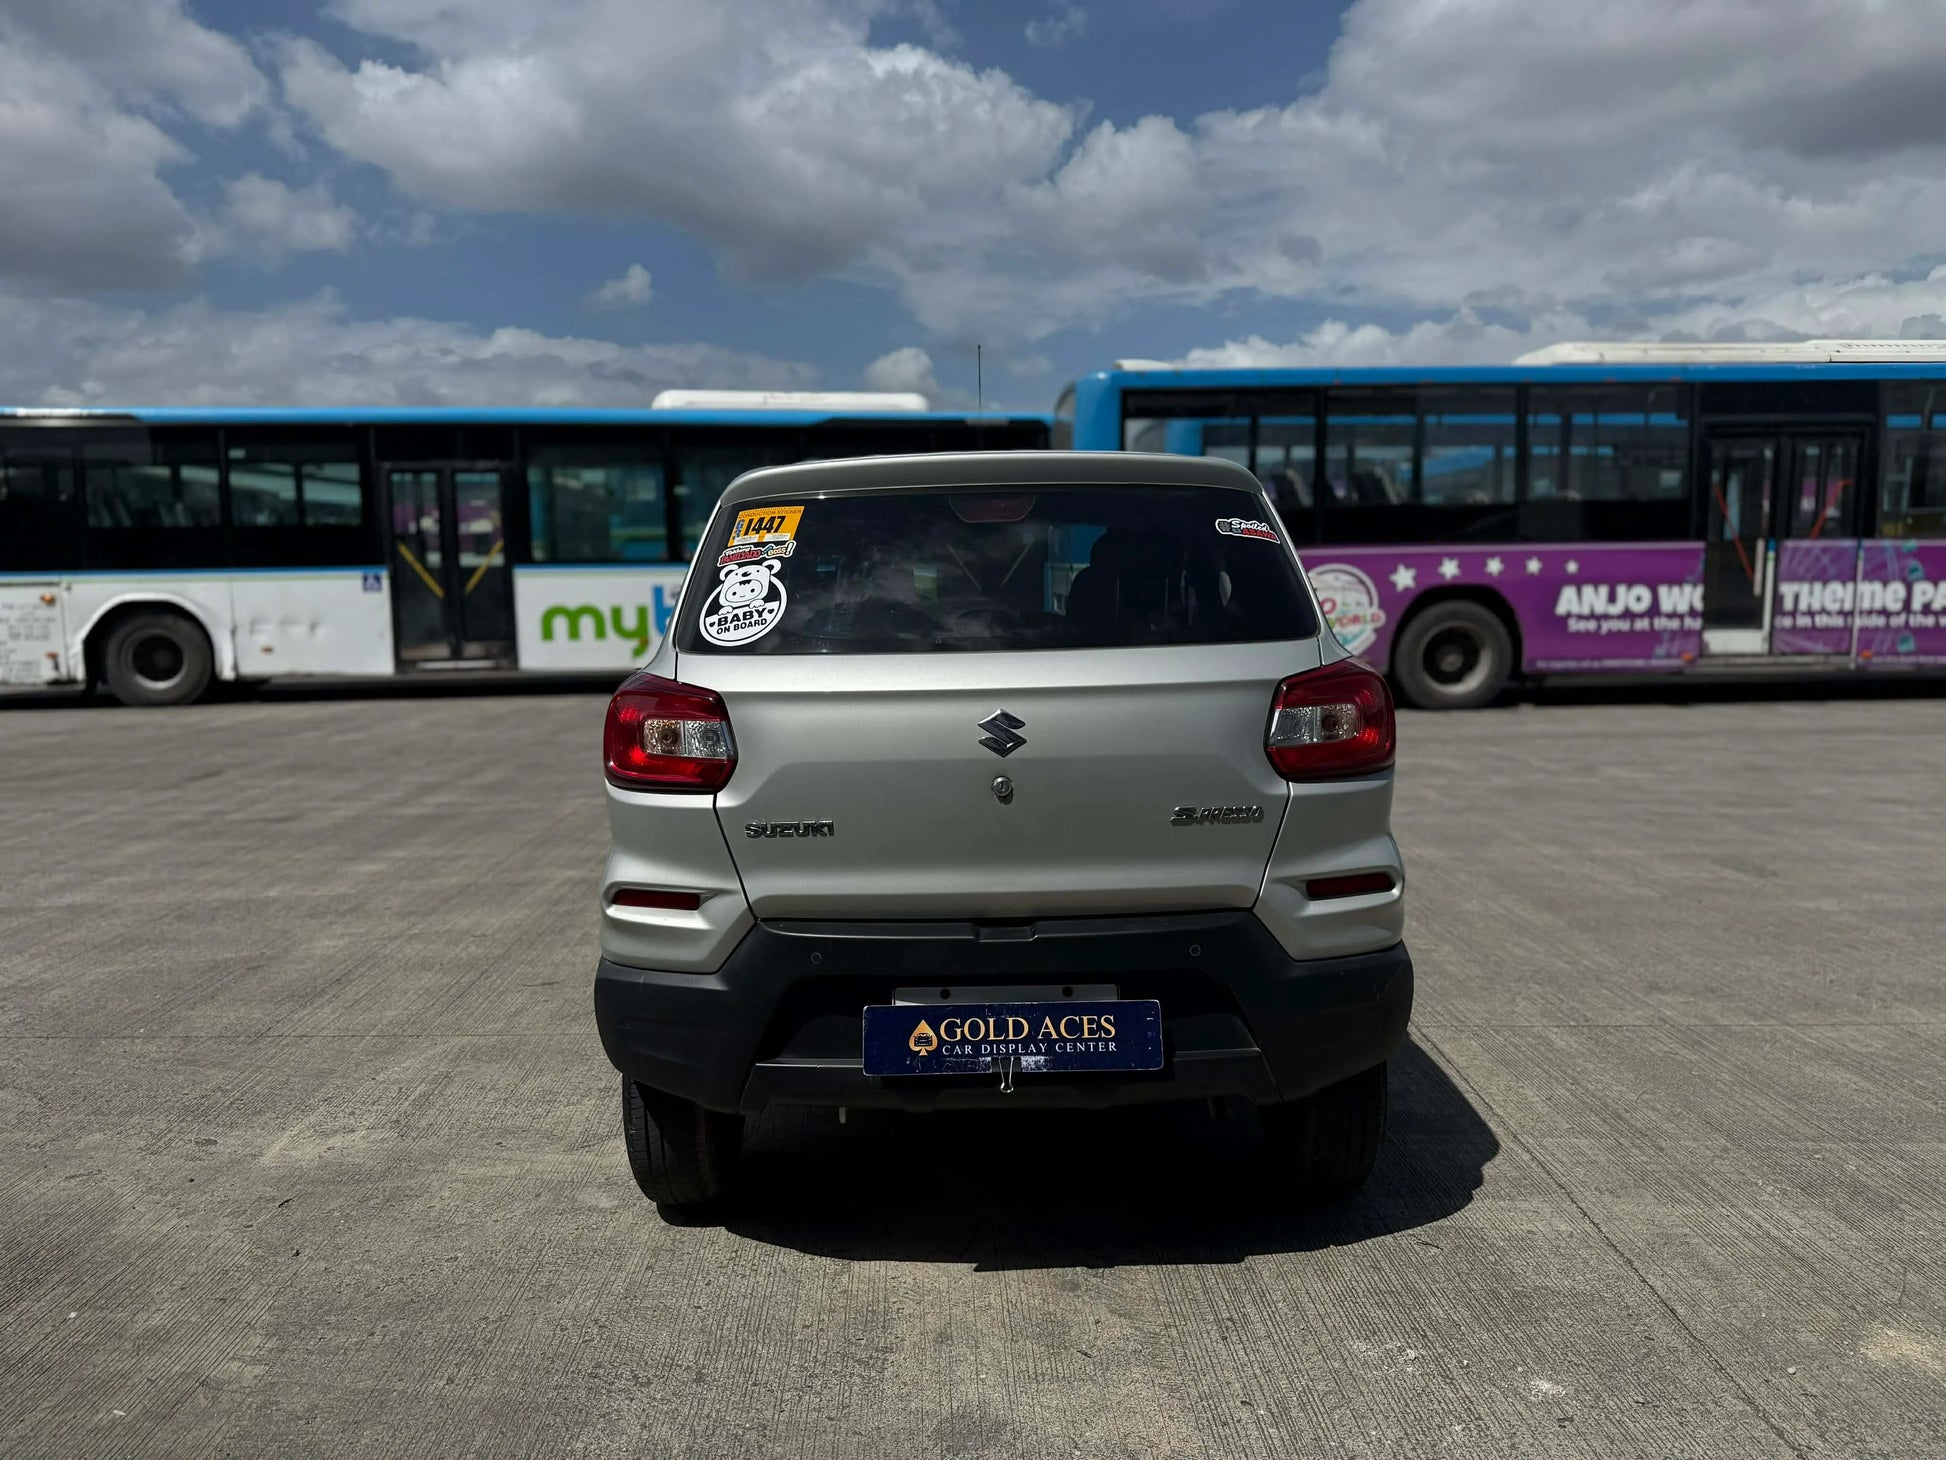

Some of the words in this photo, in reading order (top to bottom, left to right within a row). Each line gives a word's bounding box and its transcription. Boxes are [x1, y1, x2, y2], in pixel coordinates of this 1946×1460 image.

[743, 516, 786, 537] 1447
[1554, 584, 1652, 616] ANJO
[717, 607, 767, 627] BABY
[717, 626, 730, 635] ON
[733, 618, 767, 631] BOARD
[1567, 616, 1598, 632] See
[1600, 618, 1631, 635] you
[1633, 617, 1649, 631] at
[1653, 616, 1681, 631] the
[1814, 613, 1845, 629] this
[1889, 613, 1906, 629] of
[1909, 613, 1936, 629] the
[744, 821, 834, 838] SUZUKI
[939, 1017, 1029, 1042] GOLD
[1037, 1015, 1116, 1040] ACES
[942, 1045, 973, 1055] CAR
[981, 1043, 1048, 1054] DISPLAY
[1055, 1041, 1117, 1052] CENTER
